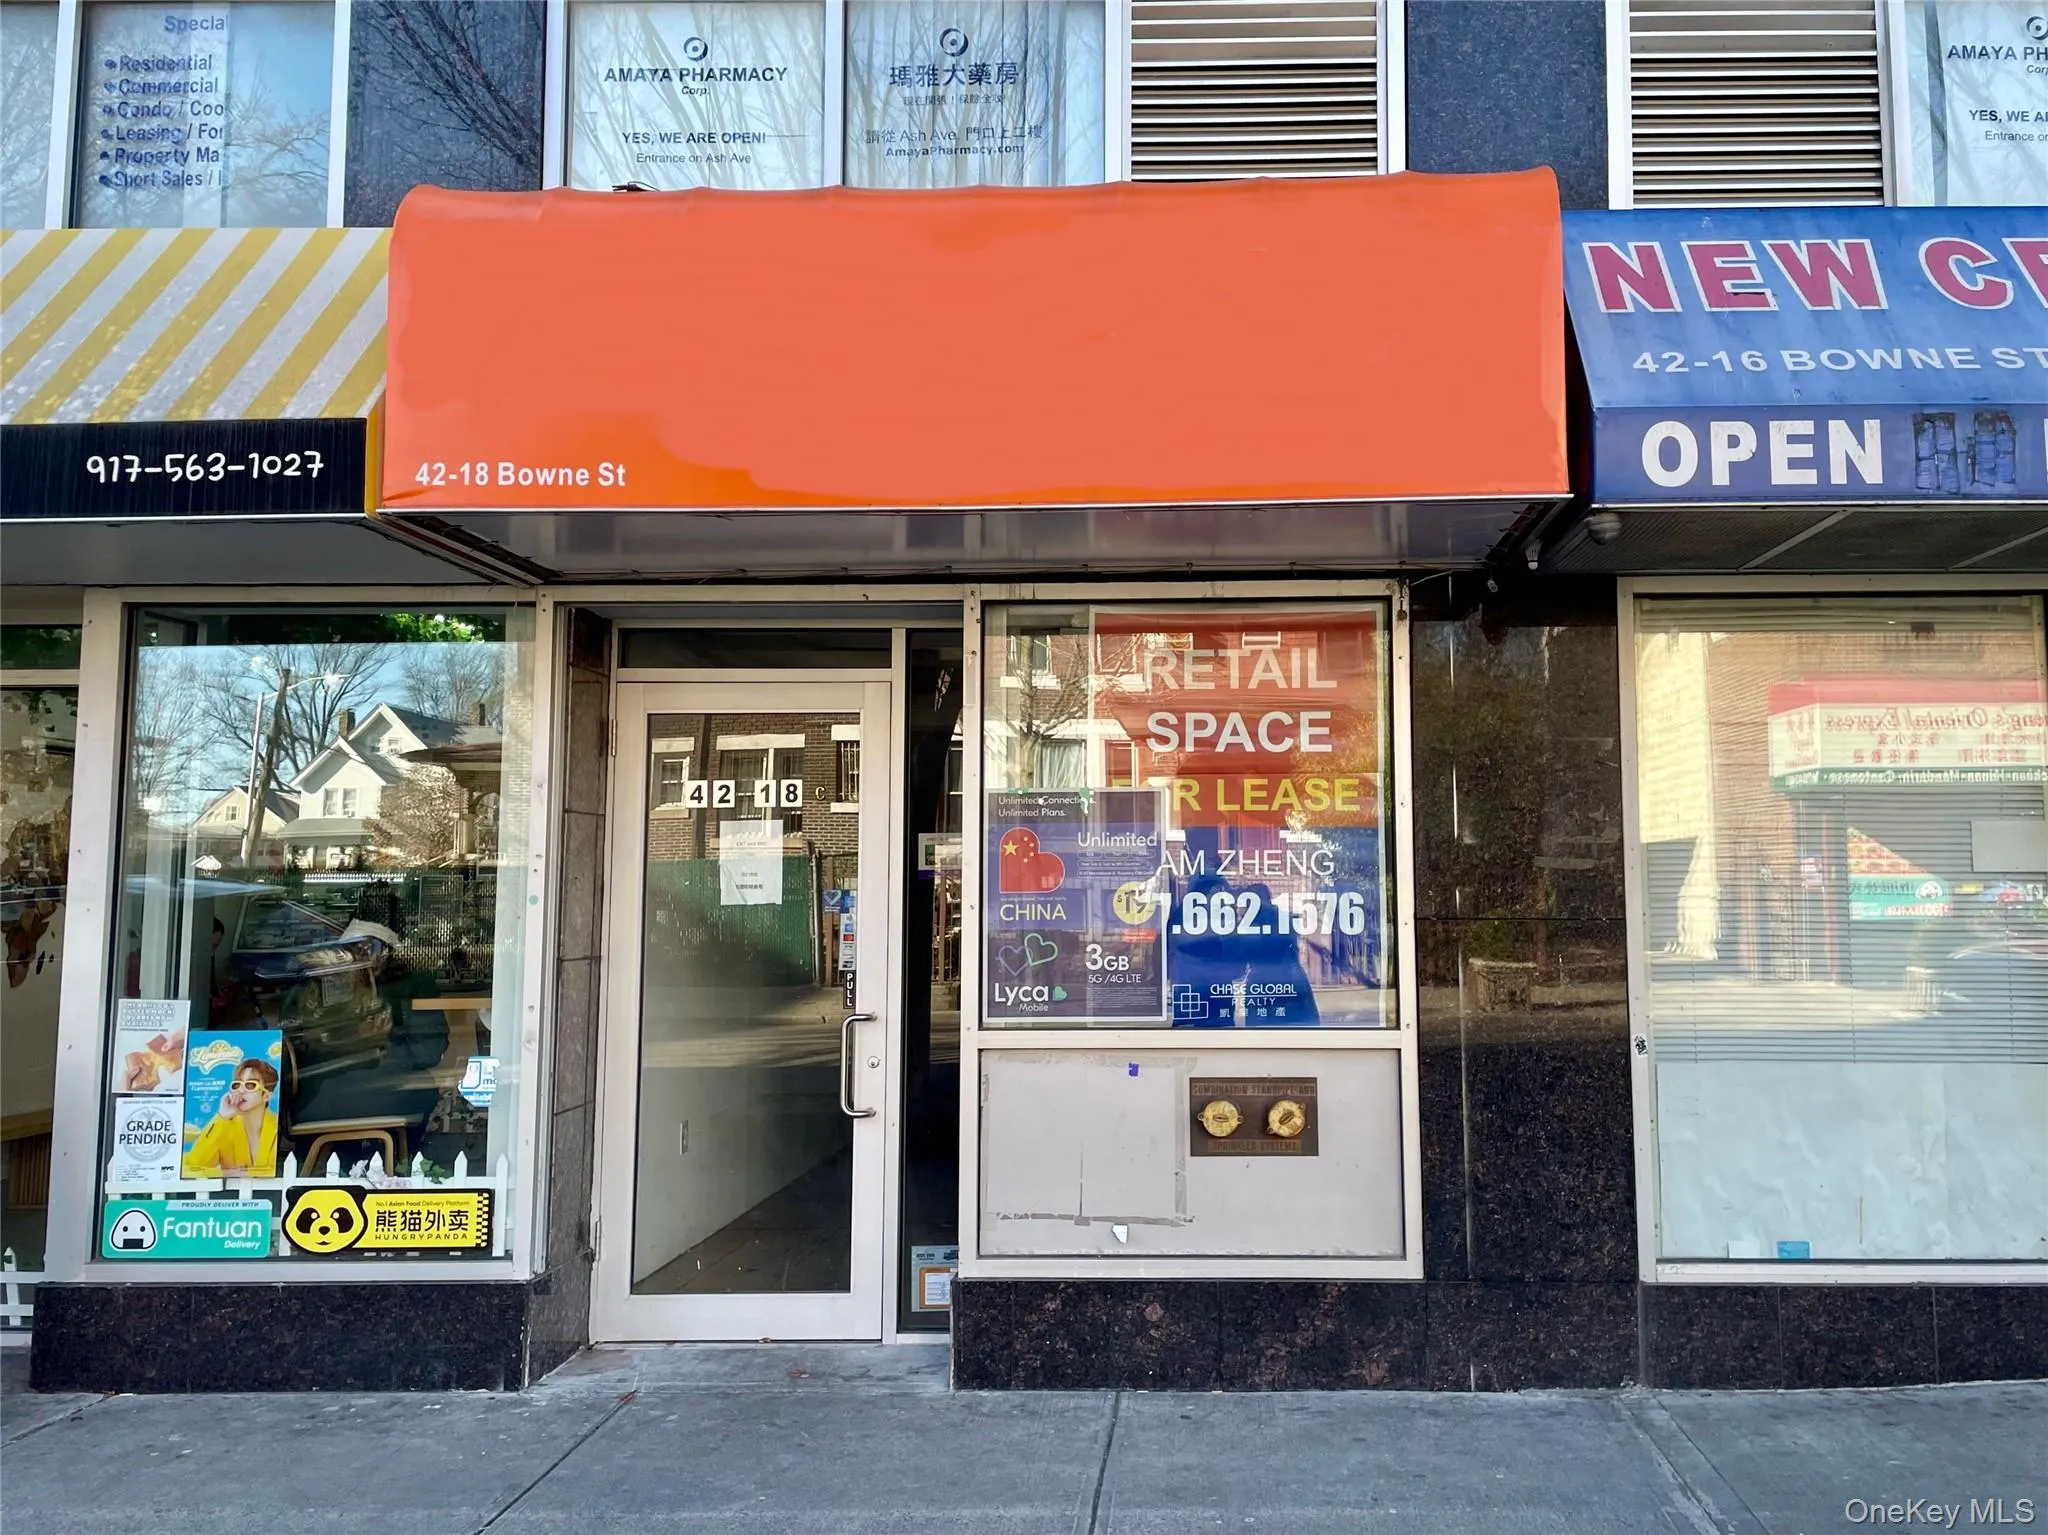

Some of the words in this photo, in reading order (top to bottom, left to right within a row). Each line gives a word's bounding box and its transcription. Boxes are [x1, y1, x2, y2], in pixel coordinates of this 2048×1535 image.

[1947, 45, 2017, 61] AMAYA
[119, 54, 213, 72] Residential
[604, 67, 672, 82] AMAYA
[679, 67, 788, 82] PHARMACY
[888, 62, 1020, 88] 瑪雅大藥房
[118, 77, 218, 95] Commercial
[681, 85, 710, 97] Corp.
[117, 100, 172, 118] Condo
[1969, 110, 2002, 123] YES,
[2006, 111, 2030, 122] WE
[116, 123, 182, 144] Leasing
[622, 132, 654, 145] YES,
[659, 132, 682, 144] WE
[686, 132, 717, 144] ARE
[721, 132, 766, 144] OPEN!
[900, 130, 926, 142] Ash
[930, 129, 960, 142] Ave.
[1985, 131, 2034, 142] Entrance
[114, 147, 190, 166] Property
[196, 146, 219, 162] Ma
[636, 152, 686, 163] Entrance
[689, 155, 702, 163] on
[706, 152, 727, 163] Ash
[730, 152, 751, 163] Ave
[886, 144, 1025, 158] AmayaPharmacy.com
[114, 169, 157, 188] Short
[161, 169, 203, 187] Sales
[1582, 239, 1889, 313] NEW
[1632, 350, 1768, 373] 42-16
[1778, 348, 1982, 371] BOWNE
[1641, 419, 1884, 487] OPEN
[86, 450, 324, 483] 917-563-1027
[415, 462, 489, 486] 42-18
[497, 461, 590, 486] Bowne
[597, 461, 626, 487] St
[1143, 647, 1338, 690] RETAIL
[1146, 711, 1333, 753] SPACE
[998, 796, 1039, 805] Unlimited
[1216, 778, 1361, 812] LEASE
[998, 808, 1039, 817] Unlimited
[1041, 808, 1067, 817] Plans.
[1077, 832, 1158, 847] Unlimited
[1216, 849, 1335, 876] ZHENG
[999, 903, 1067, 921] CHINA
[1085, 943, 1130, 971] 3GB
[1087, 974, 1103, 984] 5G
[1126, 973, 1142, 984] LTE
[846, 973, 854, 1006] PULL
[994, 982, 1049, 1006] Lyca
[1210, 983, 1247, 995] CHASE
[1249, 983, 1297, 994] GLOBAL
[1231, 997, 1276, 1006] REALTY
[126, 1120, 171, 1132] GRADE
[118, 1133, 177, 1145] PENDING
[162, 1216, 262, 1239] Fantuan
[375, 1209, 469, 1232] 熊猫外卖
[223, 1240, 261, 1250] Delivery
[375, 1233, 468, 1241] HUNGRYPANDA
